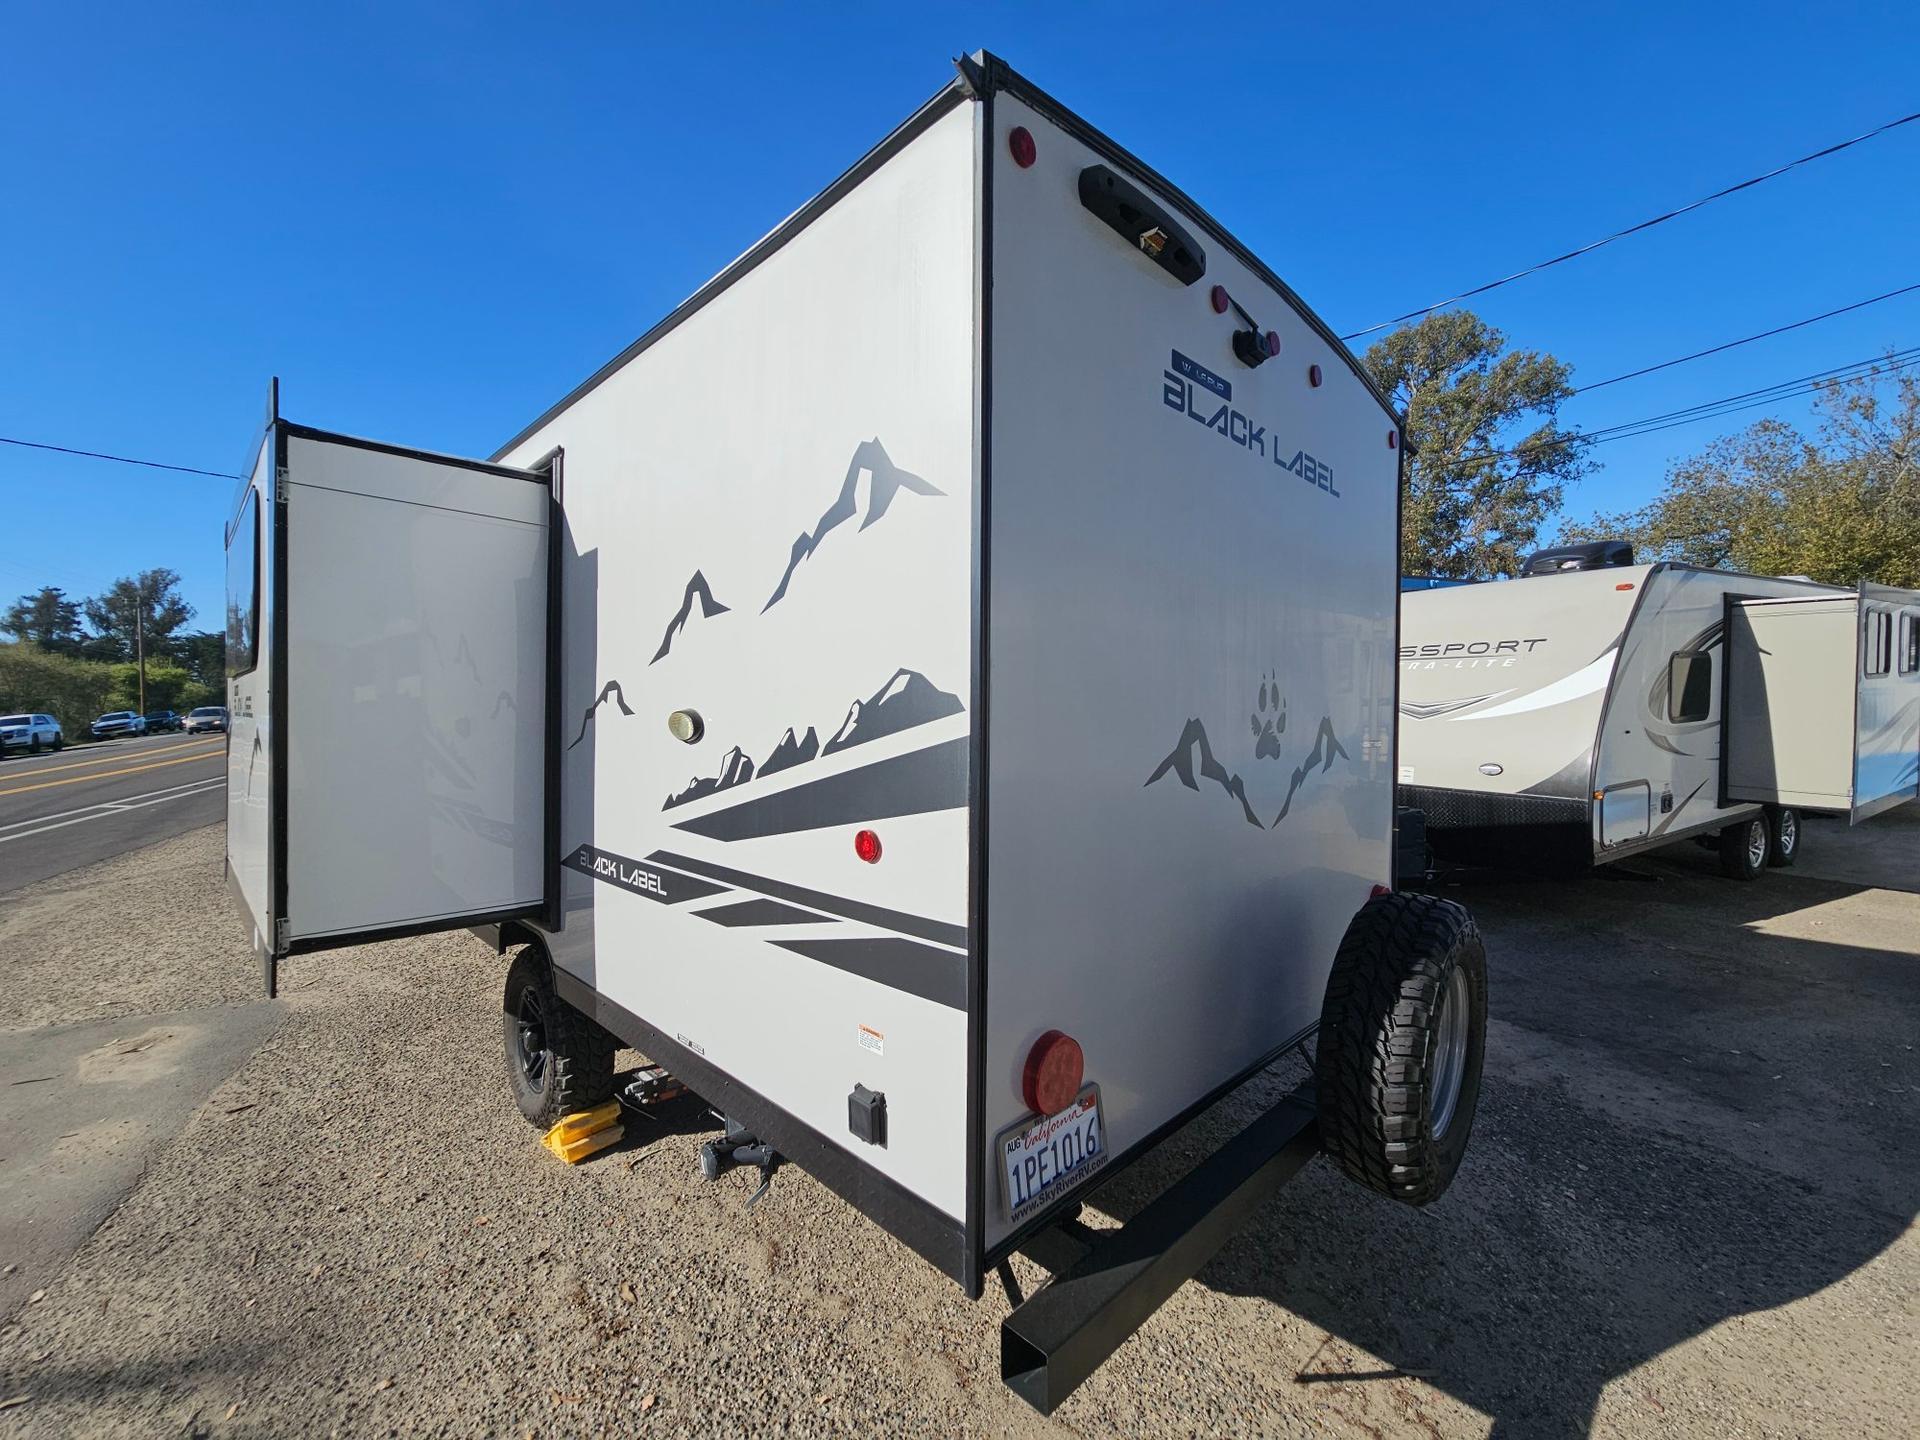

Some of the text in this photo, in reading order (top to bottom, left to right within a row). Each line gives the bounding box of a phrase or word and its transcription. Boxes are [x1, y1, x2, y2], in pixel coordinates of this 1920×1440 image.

[1163, 369, 1340, 498] BLACK LABEL
[1400, 658, 1515, 670] RA-LITE
[580, 850, 667, 896] BLACK LABEL
[1007, 1137, 1021, 1154] AUG
[1023, 1109, 1083, 1150] California
[1012, 1117, 1096, 1209] 1PE1016
